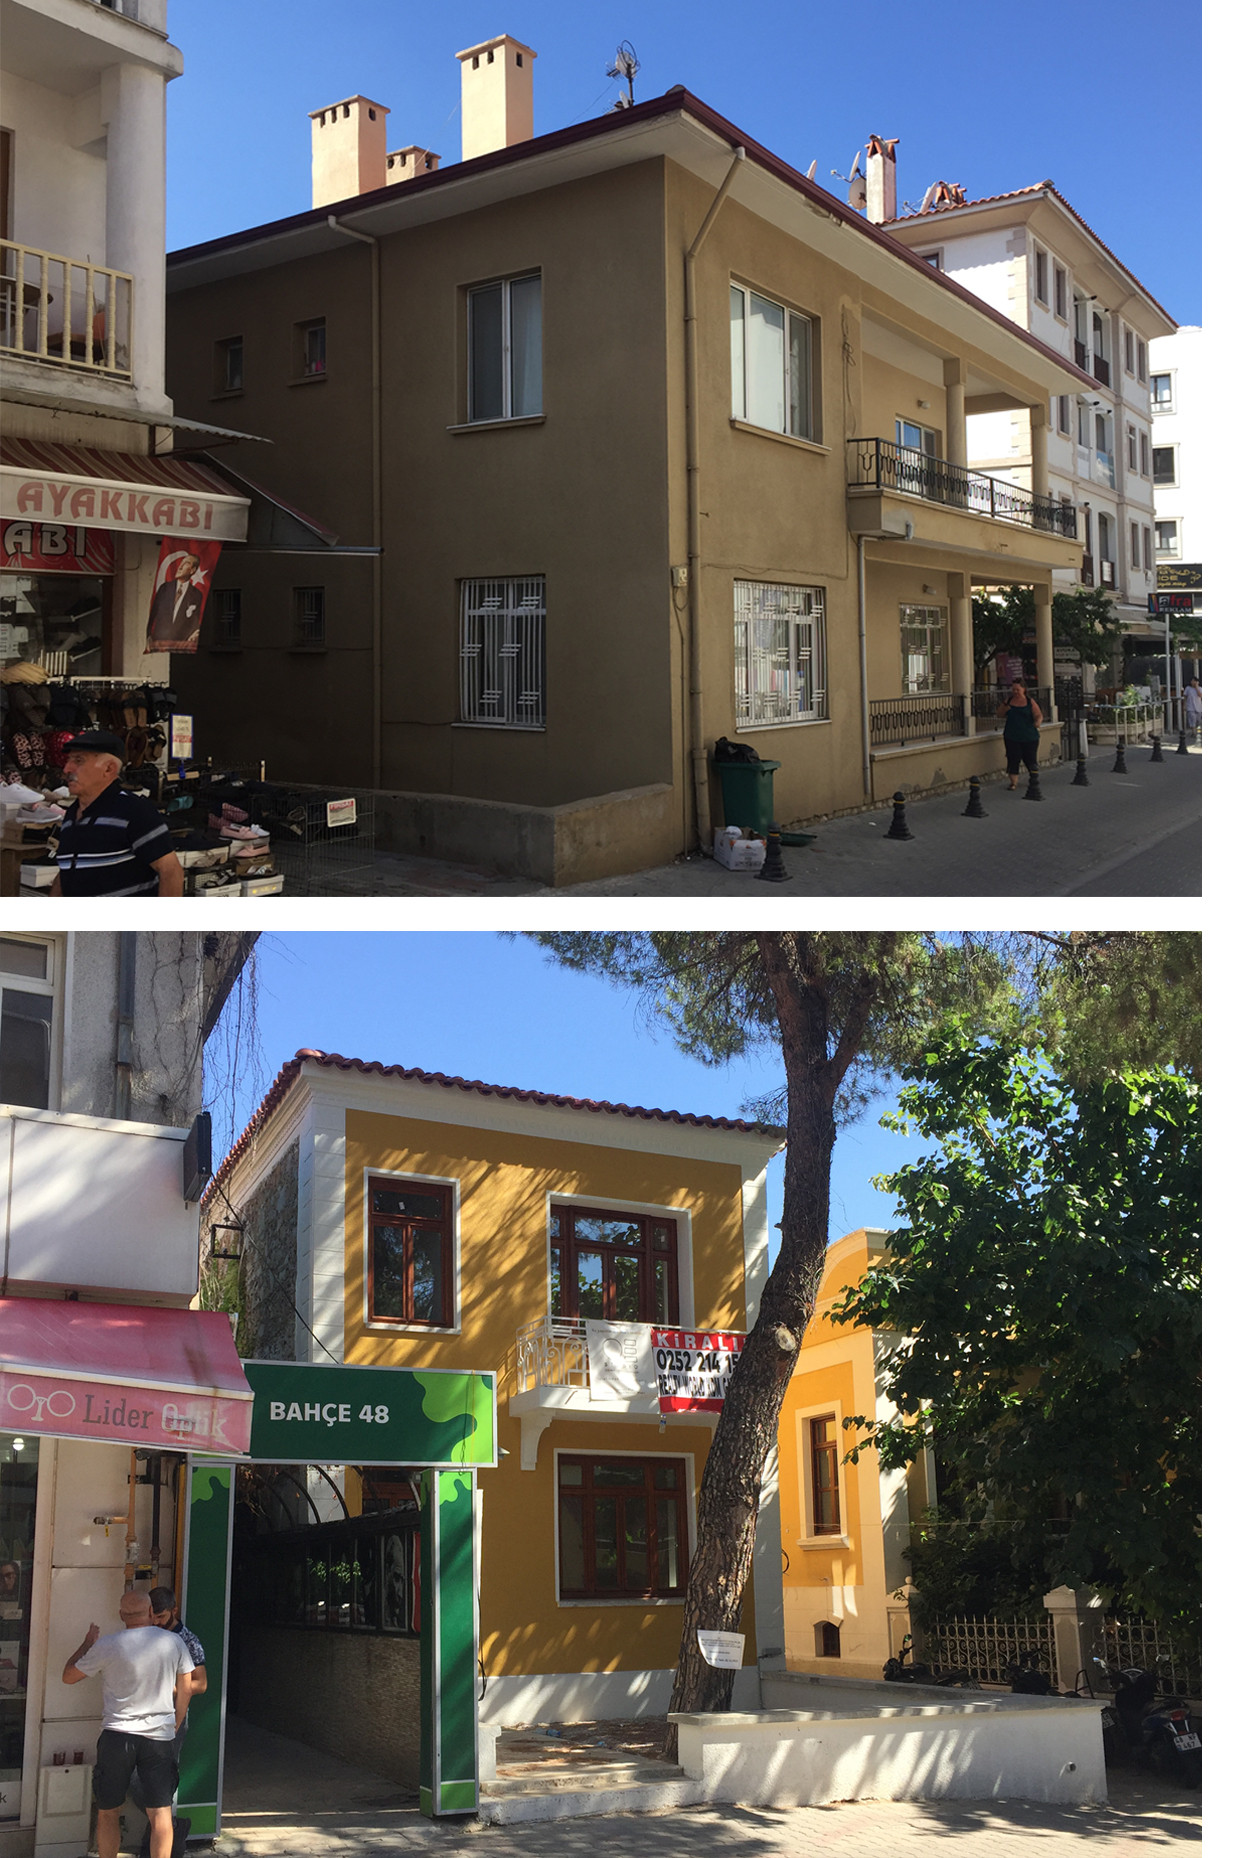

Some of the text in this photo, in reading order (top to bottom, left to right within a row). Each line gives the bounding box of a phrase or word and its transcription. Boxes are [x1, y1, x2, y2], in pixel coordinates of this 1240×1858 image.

[16, 481, 214, 530] AYAKKABI
[656, 1348, 692, 1372] 0252
[696, 1351, 720, 1373] 214
[83, 1394, 227, 1440] Lider Optik
[270, 1401, 390, 1427] BAHÇE 48
